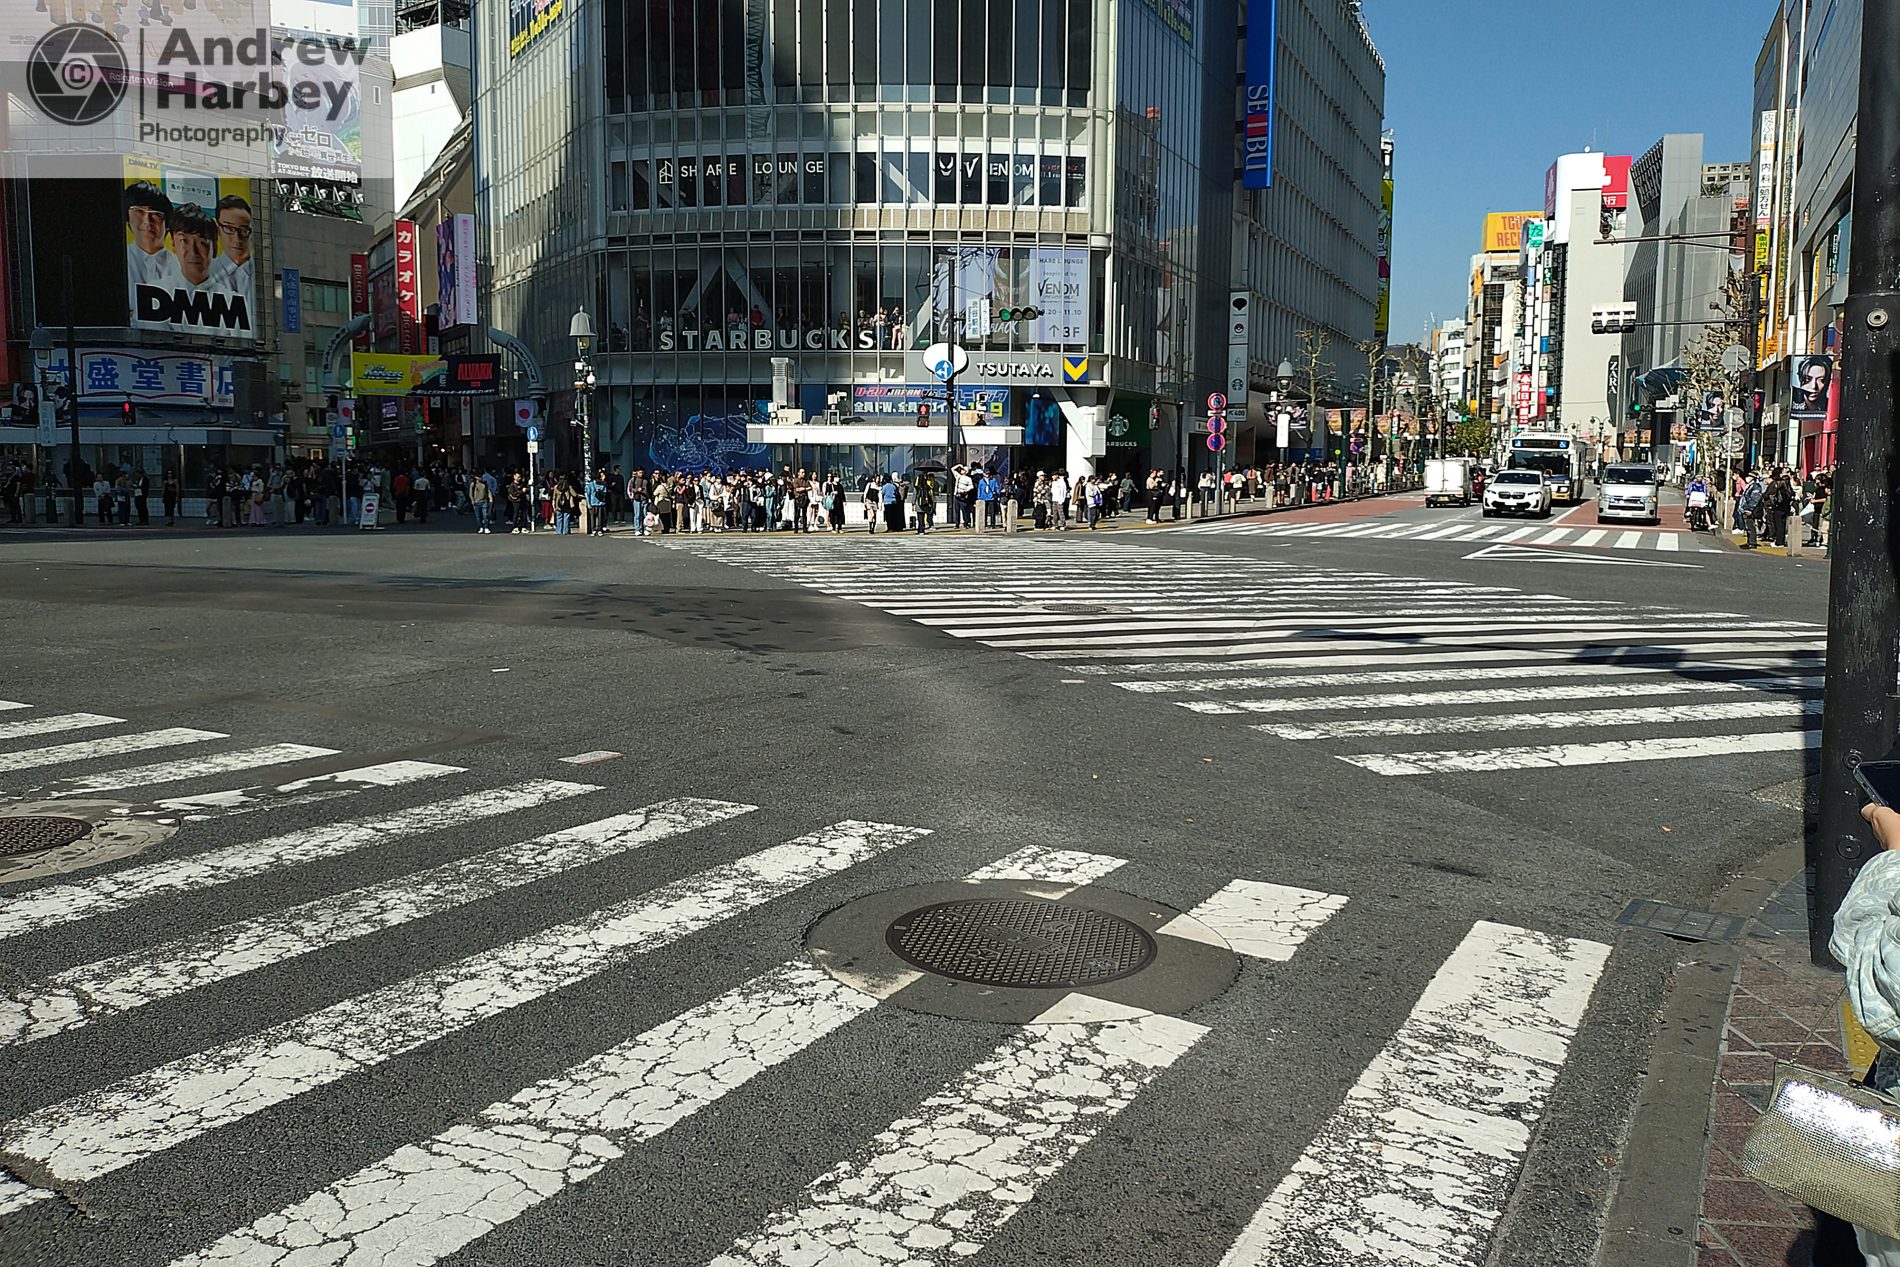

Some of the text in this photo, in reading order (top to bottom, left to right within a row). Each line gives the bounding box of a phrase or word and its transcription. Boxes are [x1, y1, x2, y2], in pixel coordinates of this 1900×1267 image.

[109, 72, 174, 88] Rakuten Vision
[1245, 85, 1269, 172] SEIBU
[1763, 113, 1774, 143] 皮ふ科
[310, 165, 359, 184] 放送開始
[680, 161, 824, 177] SHARE LOUNGE
[962, 155, 1034, 179] VENOM
[1761, 163, 1771, 184] 内科
[1758, 188, 1770, 217] 処方せん
[397, 230, 414, 302] カラオケ
[1038, 277, 1080, 297] VENOM
[135, 283, 251, 331] DMM
[659, 328, 875, 350] STARBUCKS
[457, 363, 493, 381] ALVARK
[976, 361, 1053, 376] TSUTAYA
[1608, 361, 1618, 394] ZARA
[854, 386, 886, 398] U-20
[886, 387, 924, 397] JAPAN
